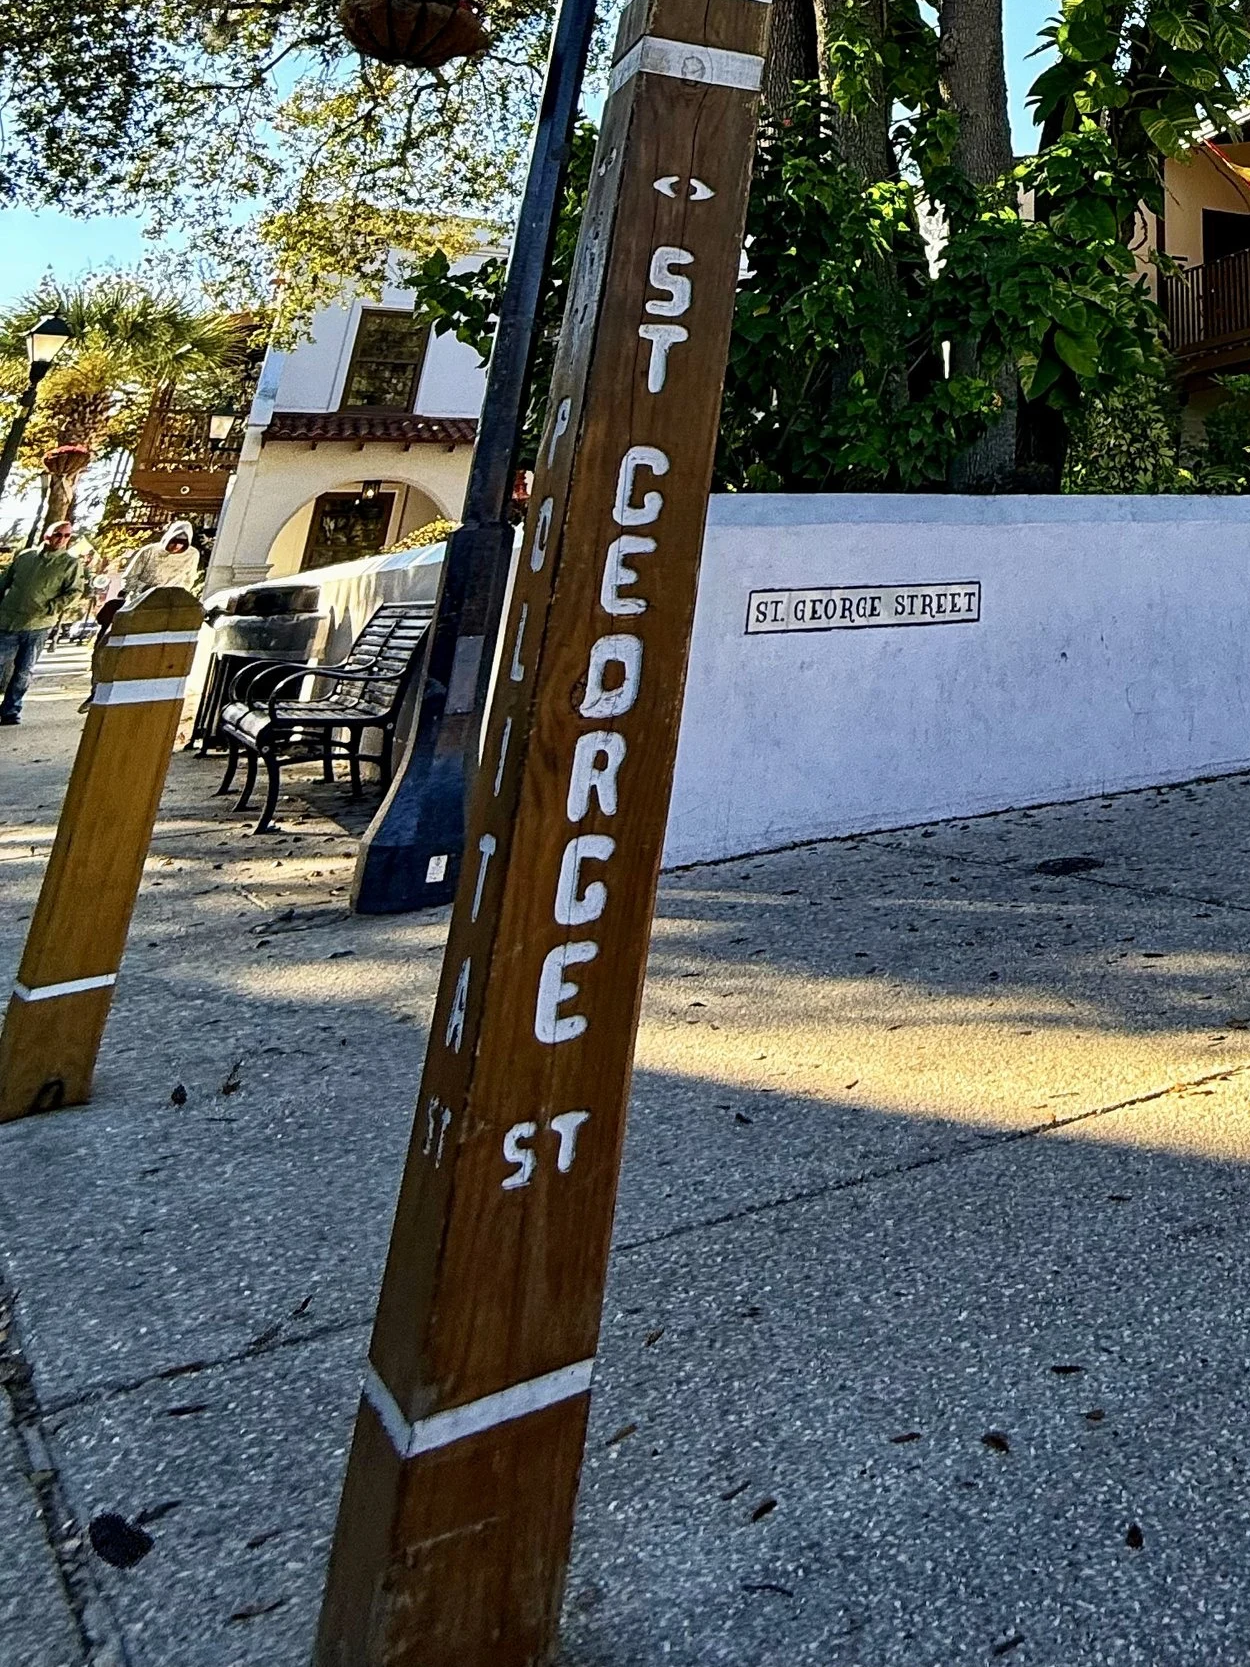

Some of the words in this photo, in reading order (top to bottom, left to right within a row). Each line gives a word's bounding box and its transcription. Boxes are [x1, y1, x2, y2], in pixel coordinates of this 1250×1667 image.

[639, 246, 695, 394] ST
[755, 600, 786, 623] ST.
[794, 596, 882, 623] GEORGE
[894, 592, 976, 618] STREET
[535, 445, 669, 1045] GEORGE
[502, 1110, 591, 1189] ST
